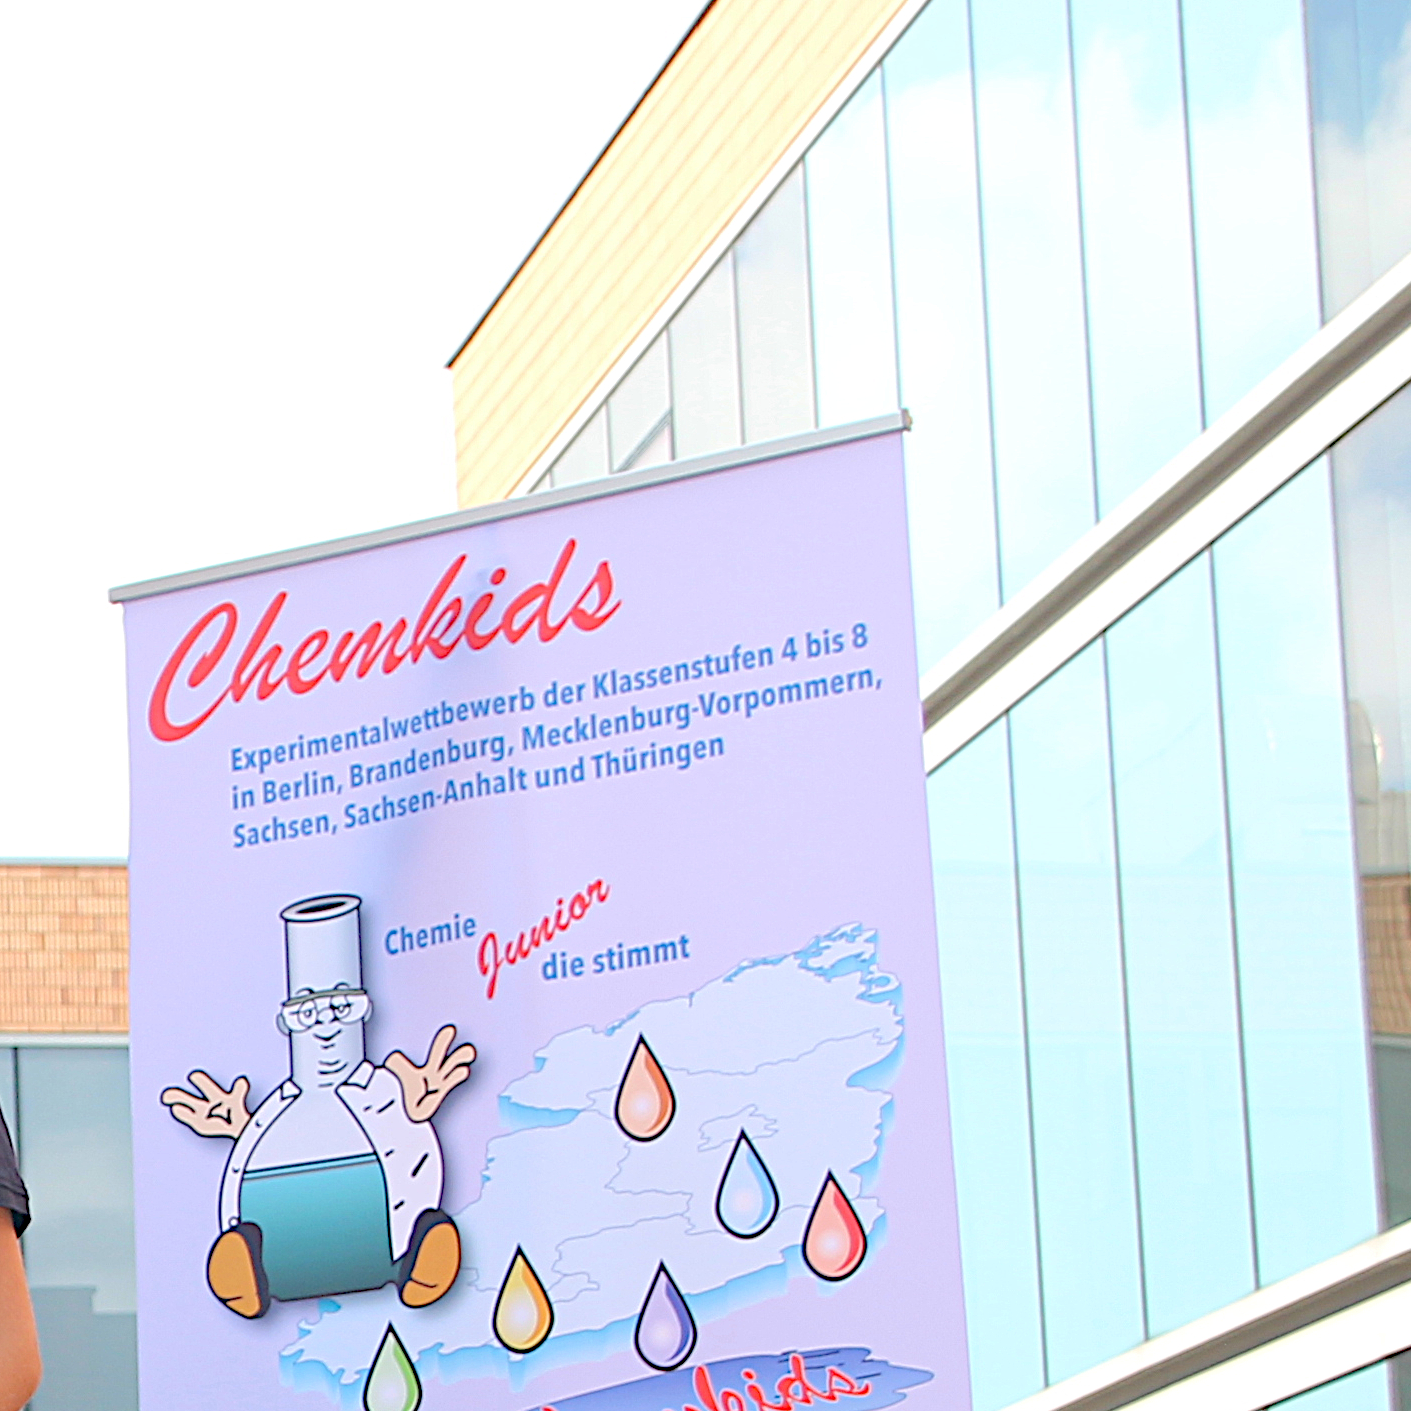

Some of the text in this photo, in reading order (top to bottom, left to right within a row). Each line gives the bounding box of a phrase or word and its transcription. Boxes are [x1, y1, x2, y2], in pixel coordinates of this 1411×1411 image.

[148, 538, 622, 742] Chemkids
[231, 623, 868, 773] Experimentalwettbewerb der Klassenstufen 4 bis 8
[232, 667, 883, 810] in Berlin, Brandenburg, Mecklenburg-Vorpommern,
[233, 736, 724, 848] Sachsen, Sachsen-Anhalt und Thüringen
[384, 913, 477, 955] Chemie
[476, 878, 610, 1000] Junior
[541, 934, 691, 980] die stimmt
